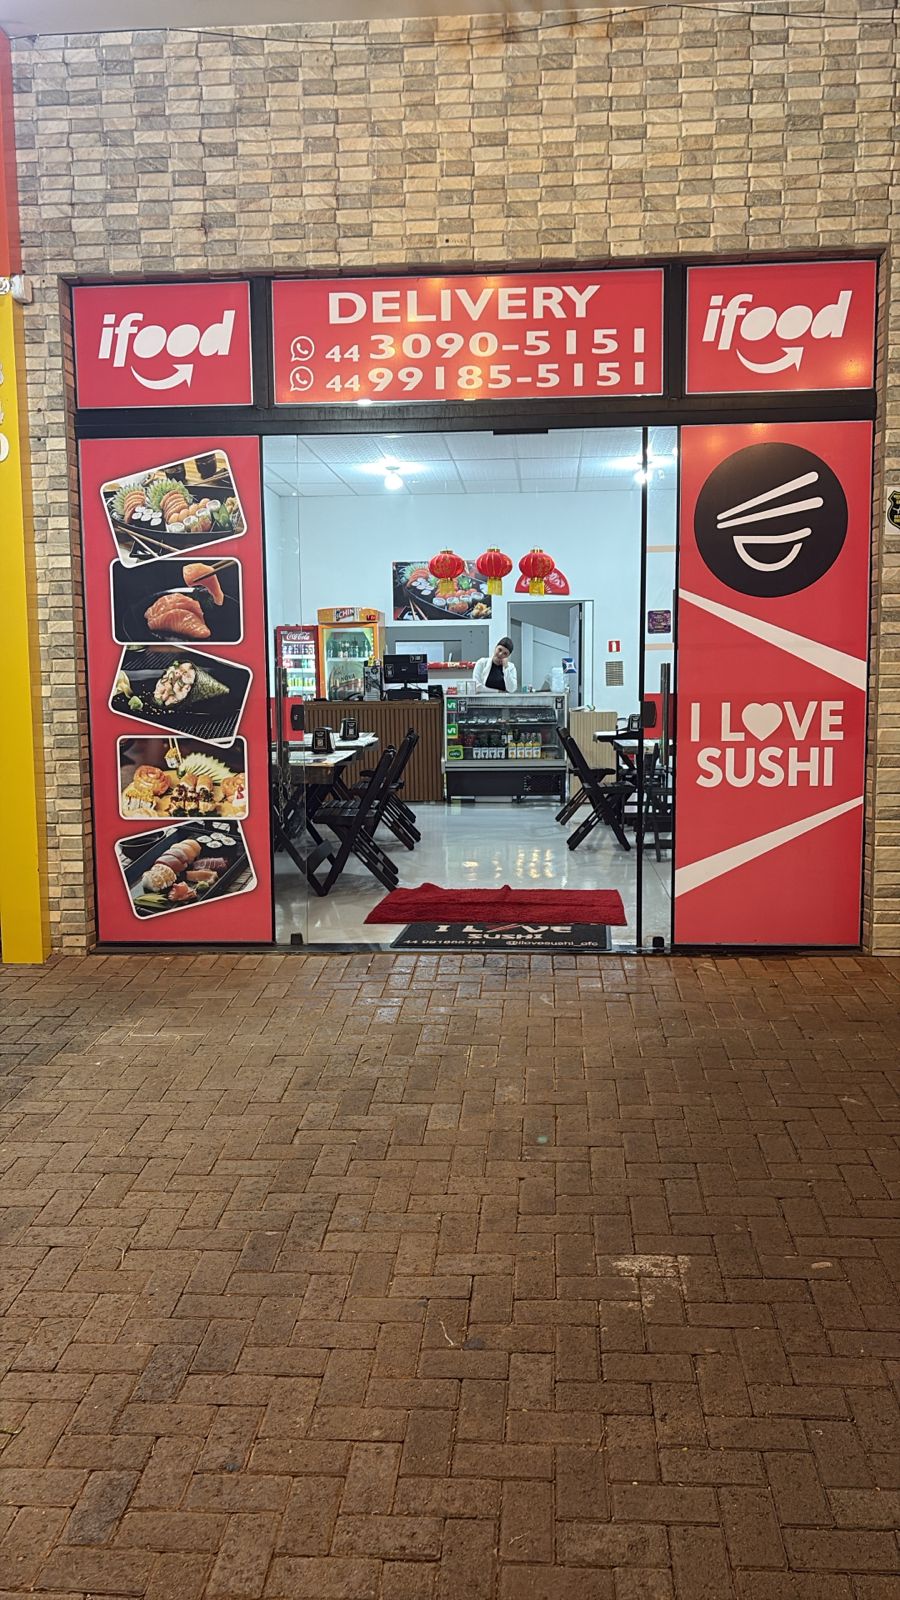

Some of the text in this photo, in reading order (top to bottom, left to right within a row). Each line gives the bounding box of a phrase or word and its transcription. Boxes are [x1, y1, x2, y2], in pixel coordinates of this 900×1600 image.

[328, 284, 601, 324] DELIVERY
[702, 290, 853, 350] ifood
[98, 309, 236, 367] ifood
[325, 327, 645, 362] 44 3090-5151
[325, 361, 645, 392] 44 99185-5151
[690, 702, 700, 742] I
[696, 746, 834, 788] SUSHI
